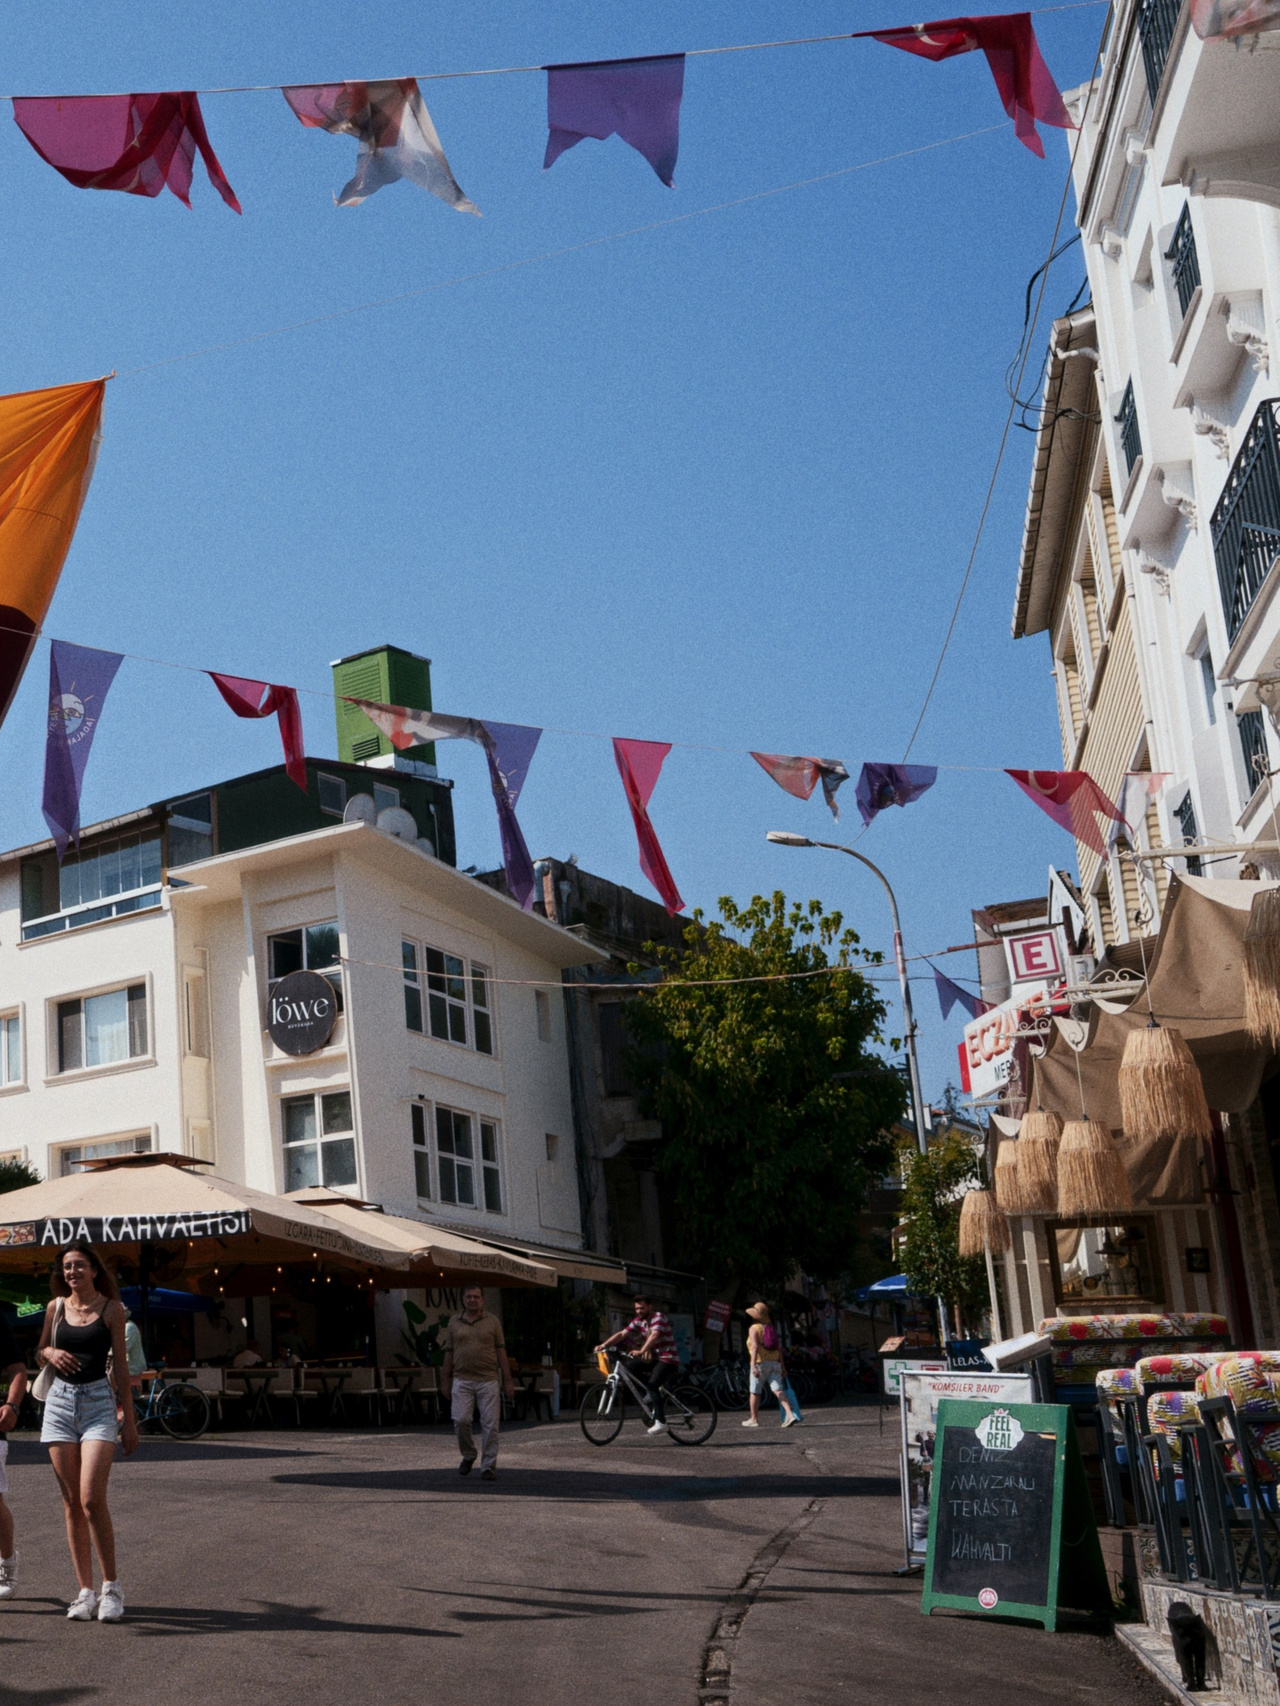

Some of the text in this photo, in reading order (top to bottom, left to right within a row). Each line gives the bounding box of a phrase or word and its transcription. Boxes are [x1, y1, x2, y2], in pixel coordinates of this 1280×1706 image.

[1021, 941, 1048, 971] E
[271, 996, 330, 1026] löwe
[40, 1217, 92, 1247] ADA
[989, 1415, 1012, 1431] FEEL
[986, 1432, 1013, 1449] REAL
